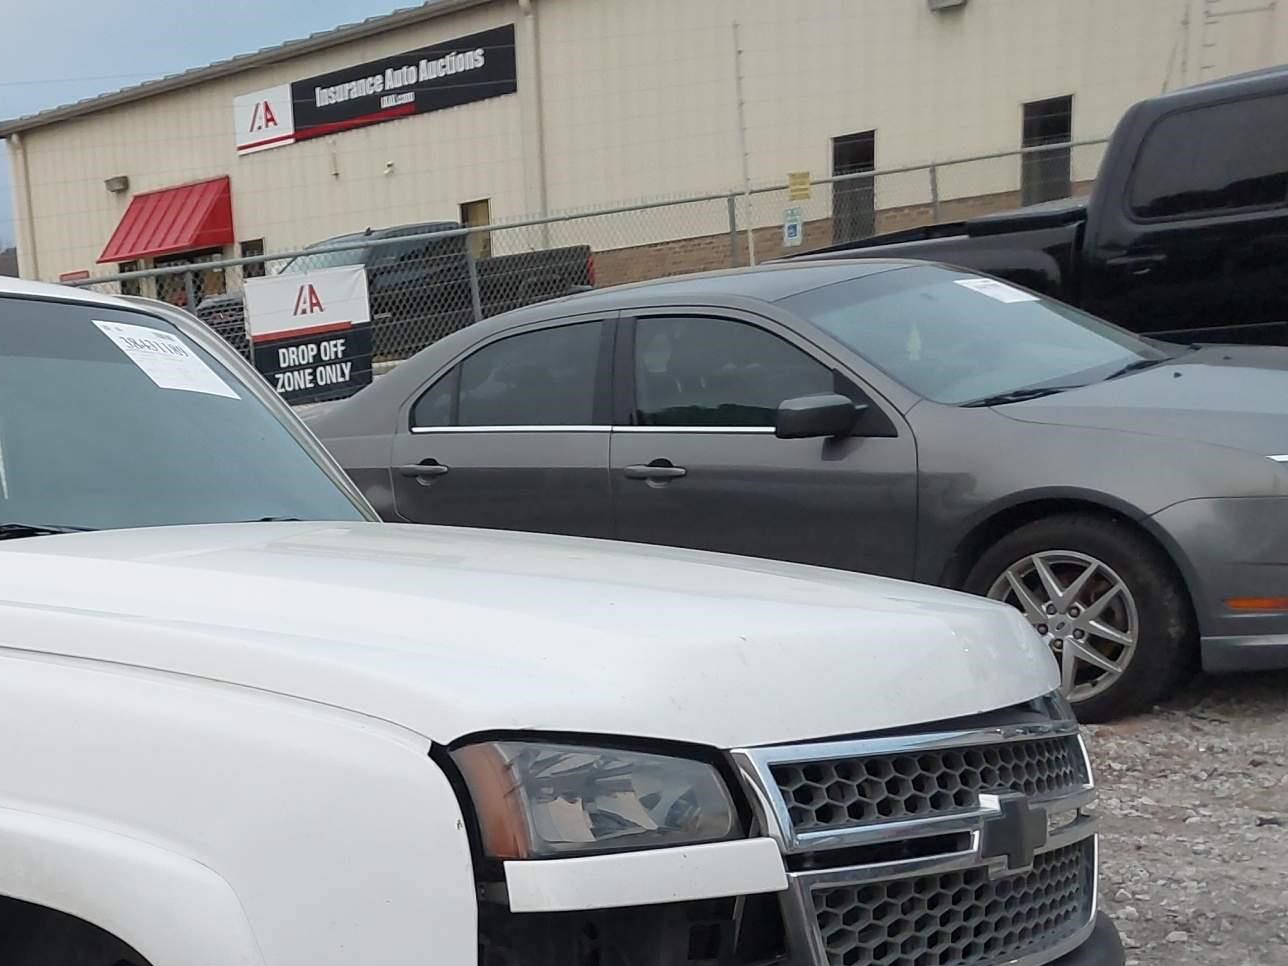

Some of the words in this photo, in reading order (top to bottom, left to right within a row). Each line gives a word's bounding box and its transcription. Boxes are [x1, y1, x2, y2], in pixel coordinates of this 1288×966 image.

[314, 74, 384, 108] Insurance
[384, 65, 418, 91] Auto
[418, 48, 485, 82] Auctions
[278, 344, 318, 368] DROP
[320, 339, 346, 361] OFF
[275, 369, 314, 393] ZONE
[316, 362, 352, 386] ONLY
